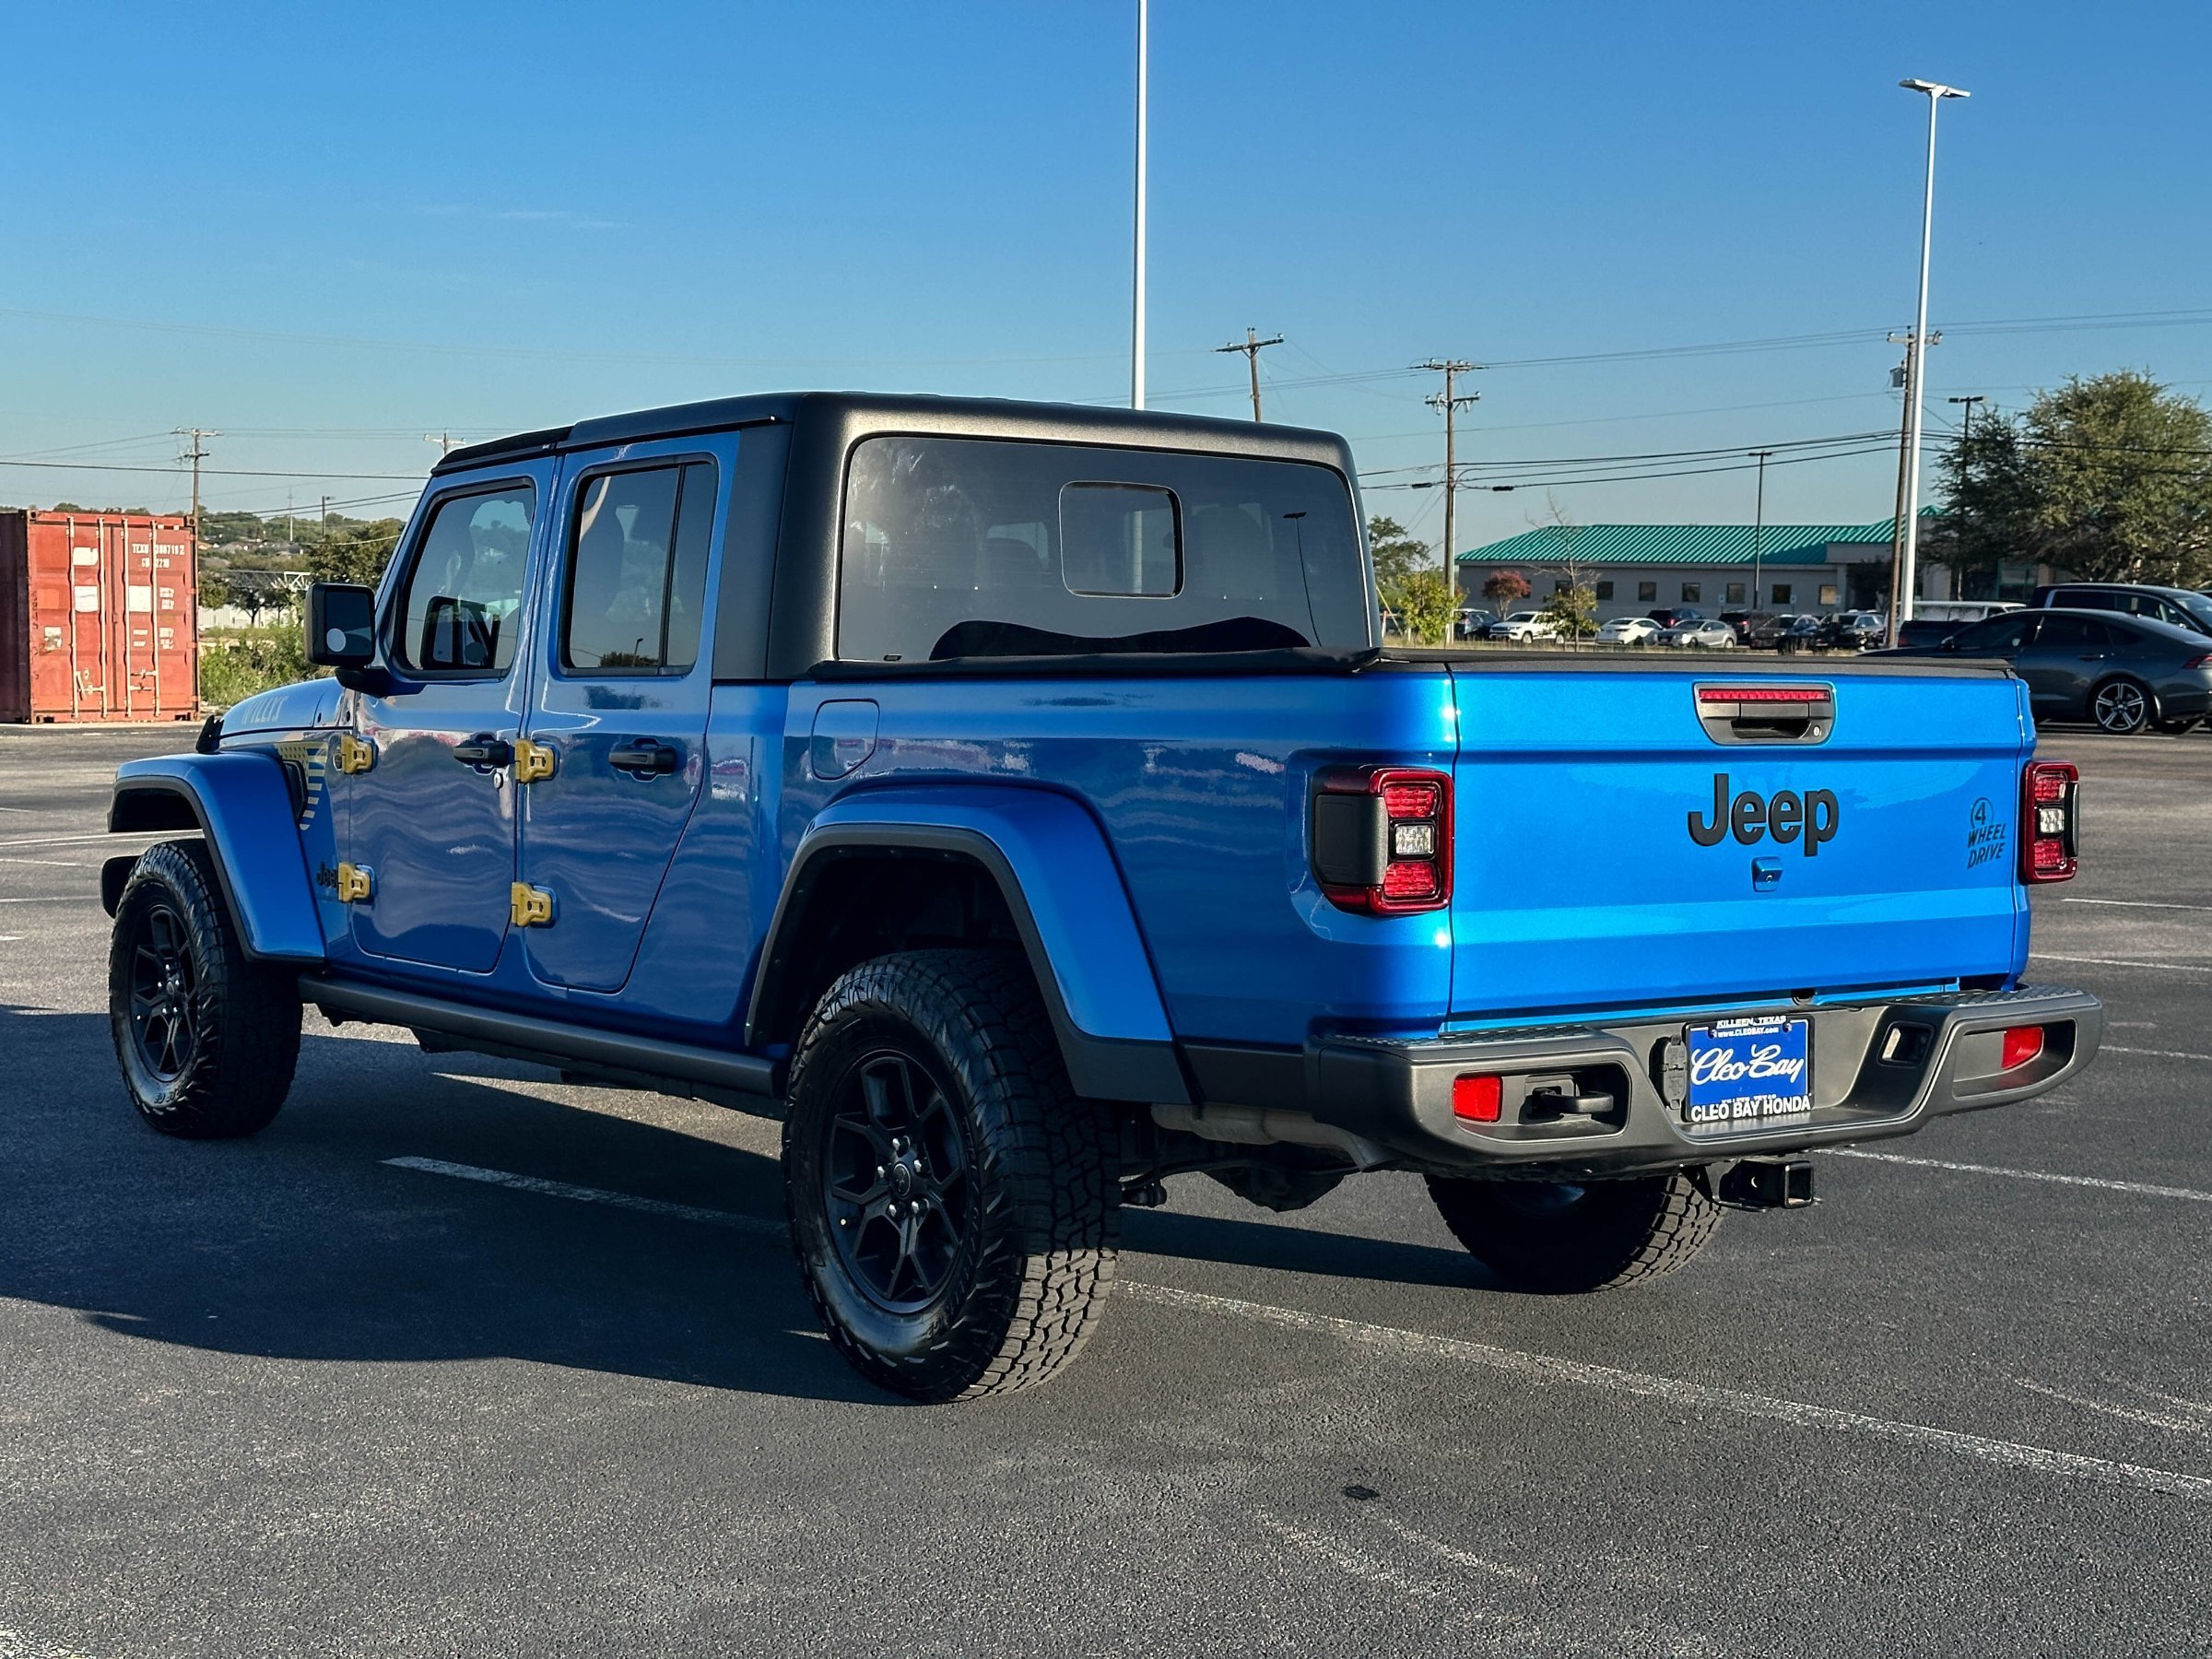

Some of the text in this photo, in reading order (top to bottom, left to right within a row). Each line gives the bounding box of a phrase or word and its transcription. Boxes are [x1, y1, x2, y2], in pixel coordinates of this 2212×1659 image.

[1688, 773, 1839, 856] Jeep
[1974, 801, 1986, 825] 4
[1968, 823, 2006, 848] WHEEL
[1967, 842, 2006, 869] DRIVE
[316, 861, 338, 888] Jee
[1756, 1016, 1786, 1026] TEXAS
[1690, 1048, 1748, 1085] Cleo
[1747, 1044, 1804, 1083] Bay
[1691, 1096, 1811, 1122] CLEO BAY HONDA
